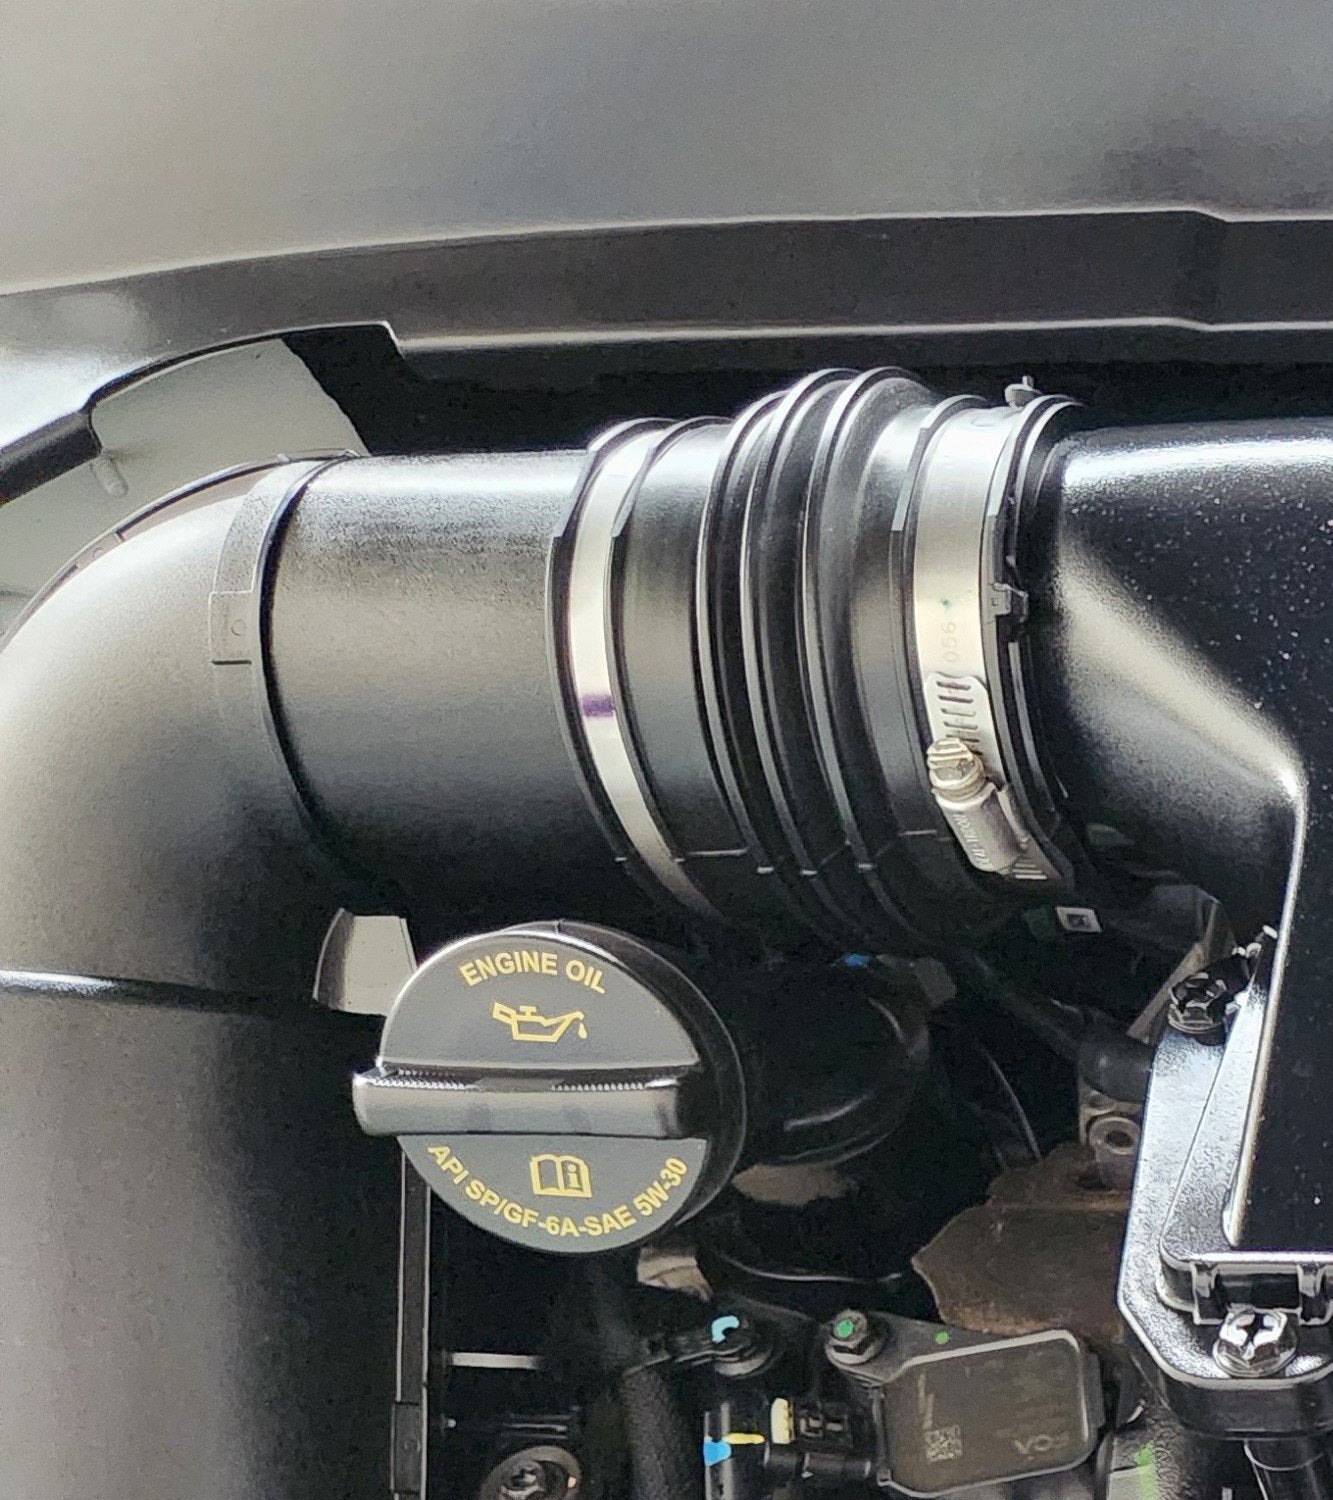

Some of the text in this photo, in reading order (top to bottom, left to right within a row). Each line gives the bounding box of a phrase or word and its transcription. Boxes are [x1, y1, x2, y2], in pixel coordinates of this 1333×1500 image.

[460, 950, 607, 994] ENGINE OIL
[428, 1145, 689, 1237] API SP/GF-6A-SAE 5W-30
